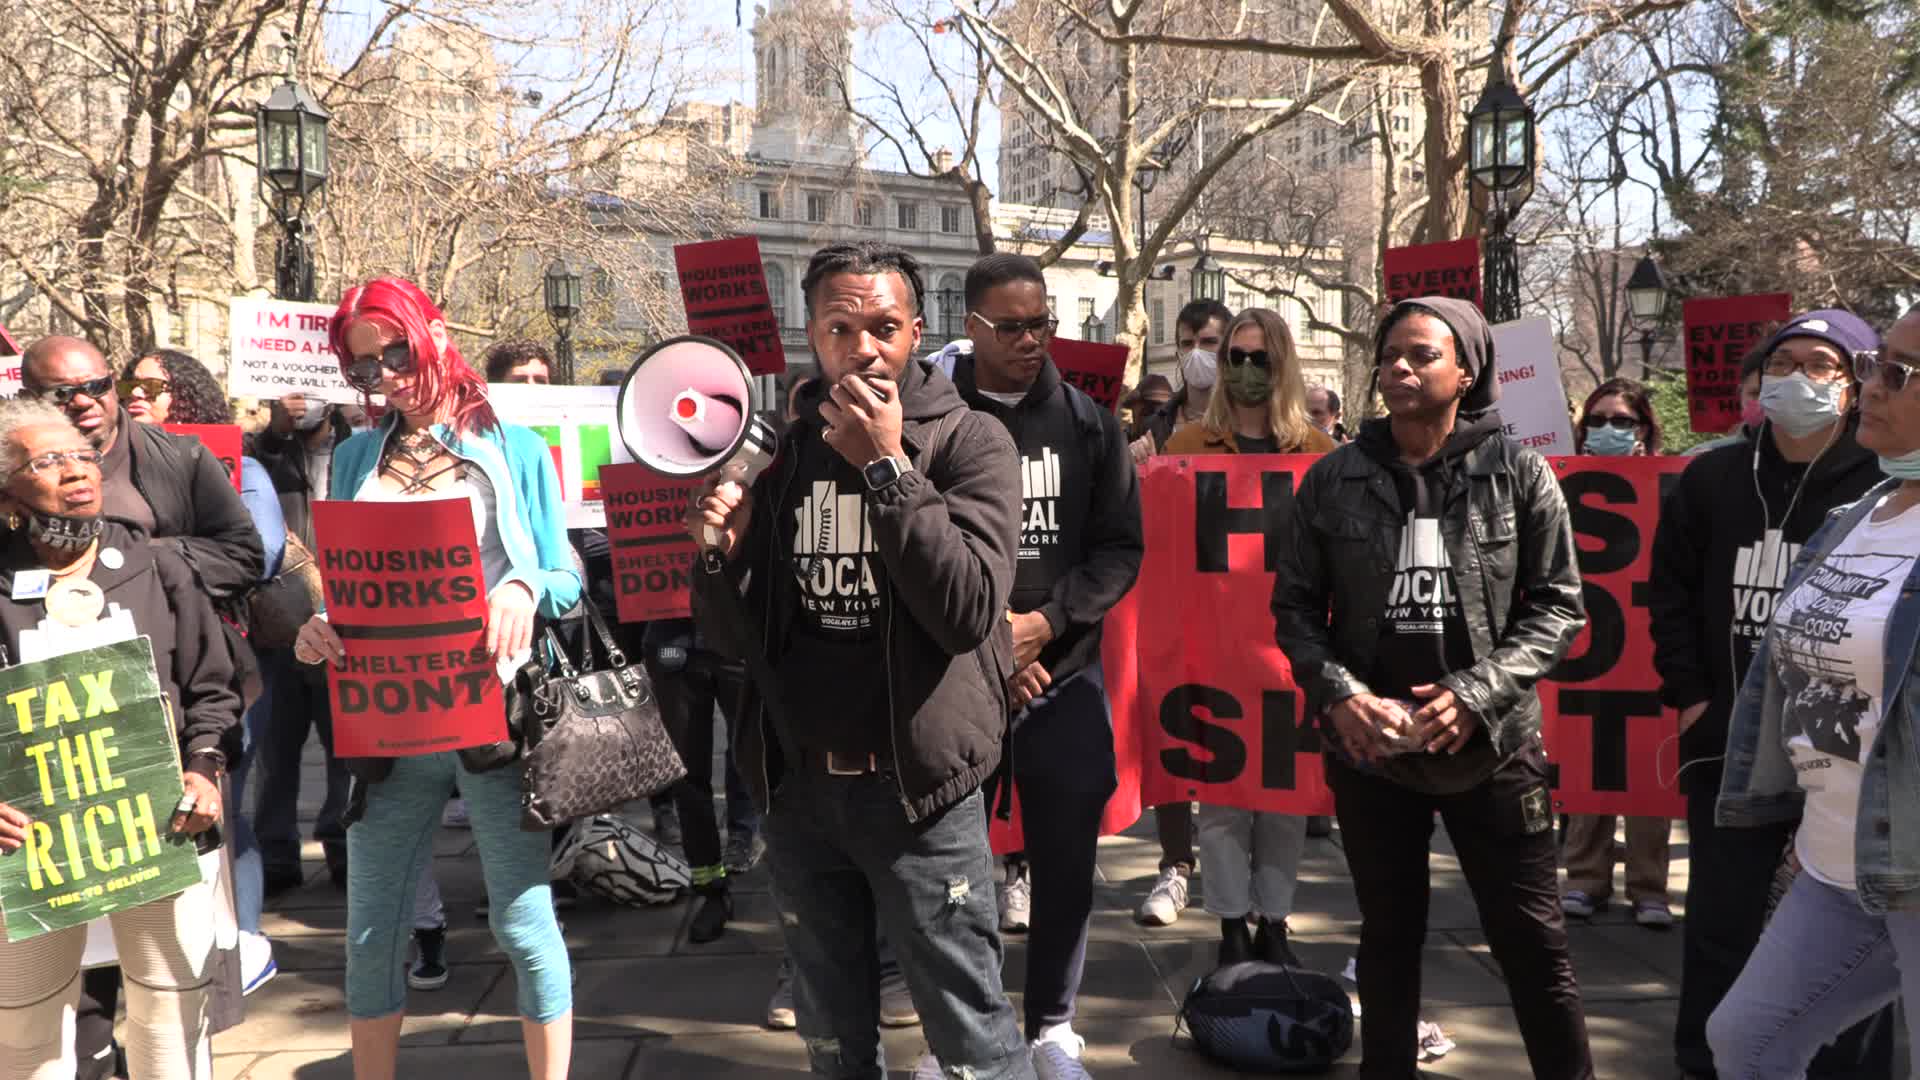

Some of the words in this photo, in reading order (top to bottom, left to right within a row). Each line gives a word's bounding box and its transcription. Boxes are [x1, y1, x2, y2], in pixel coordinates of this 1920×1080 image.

[1390, 265, 1474, 289] EVERY
[686, 280, 764, 303] WORKS
[257, 302, 289, 328] I'M
[296, 314, 333, 332] TIR
[1690, 321, 1765, 342] EVER
[250, 337, 296, 353] NEED
[301, 343, 313, 354] A
[1690, 343, 1745, 367] NE
[243, 360, 267, 369] NOT
[272, 361, 279, 370] A
[283, 363, 338, 375] VOUCHER
[251, 375, 268, 383] NO
[272, 376, 297, 386] ONE
[300, 378, 327, 388] WILL
[608, 486, 692, 507] HOUSIN
[611, 504, 690, 529] WORK
[1020, 535, 1059, 545] YORK
[325, 546, 473, 573] HOUSING
[617, 552, 692, 569] SHELTE
[328, 575, 478, 609] WORKS
[1804, 617, 1844, 640] COPS
[661, 648, 680, 658] JBL
[7, 670, 119, 734] TAX
[26, 727, 126, 806] THE
[26, 793, 162, 891] RICH
[48, 891, 81, 908] TIME
[84, 885, 103, 897] TO
[107, 867, 161, 892] DELIVER
